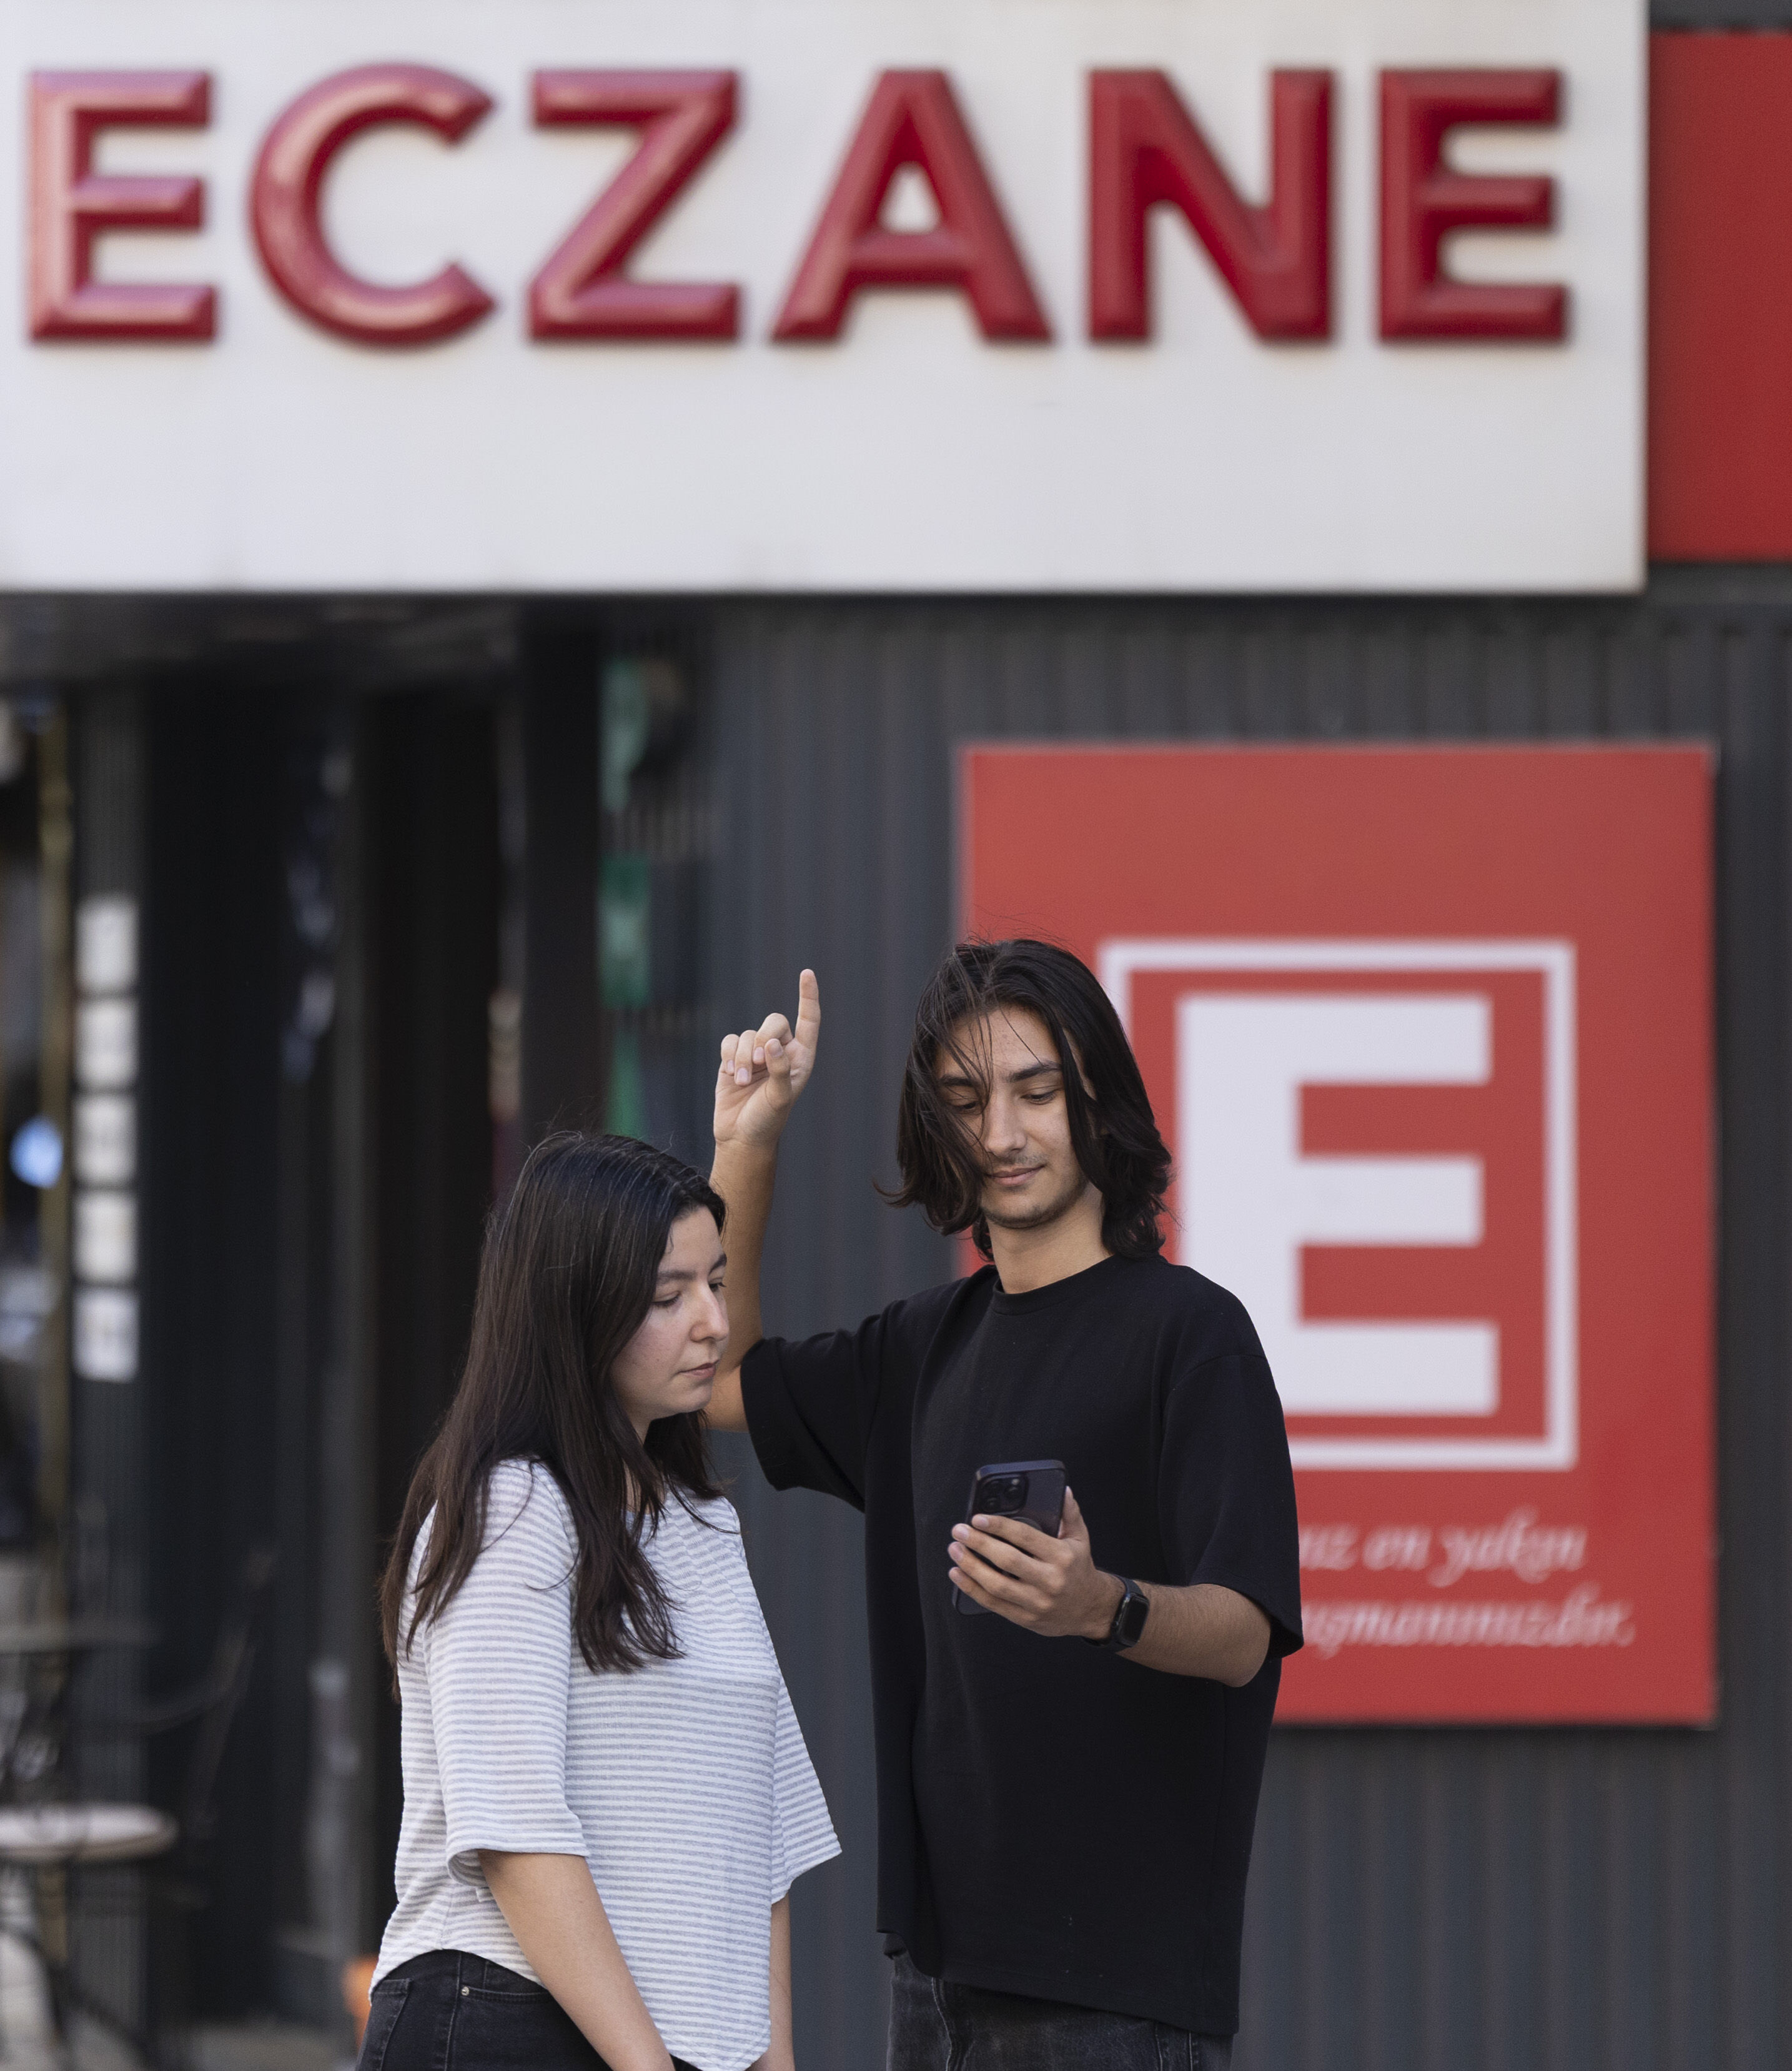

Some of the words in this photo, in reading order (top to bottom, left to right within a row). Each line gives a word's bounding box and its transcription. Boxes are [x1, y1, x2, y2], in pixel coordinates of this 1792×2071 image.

[26, 63, 1568, 347] ECZANE
[1177, 996, 1497, 1415] E
[1363, 1525, 1431, 1571] en
